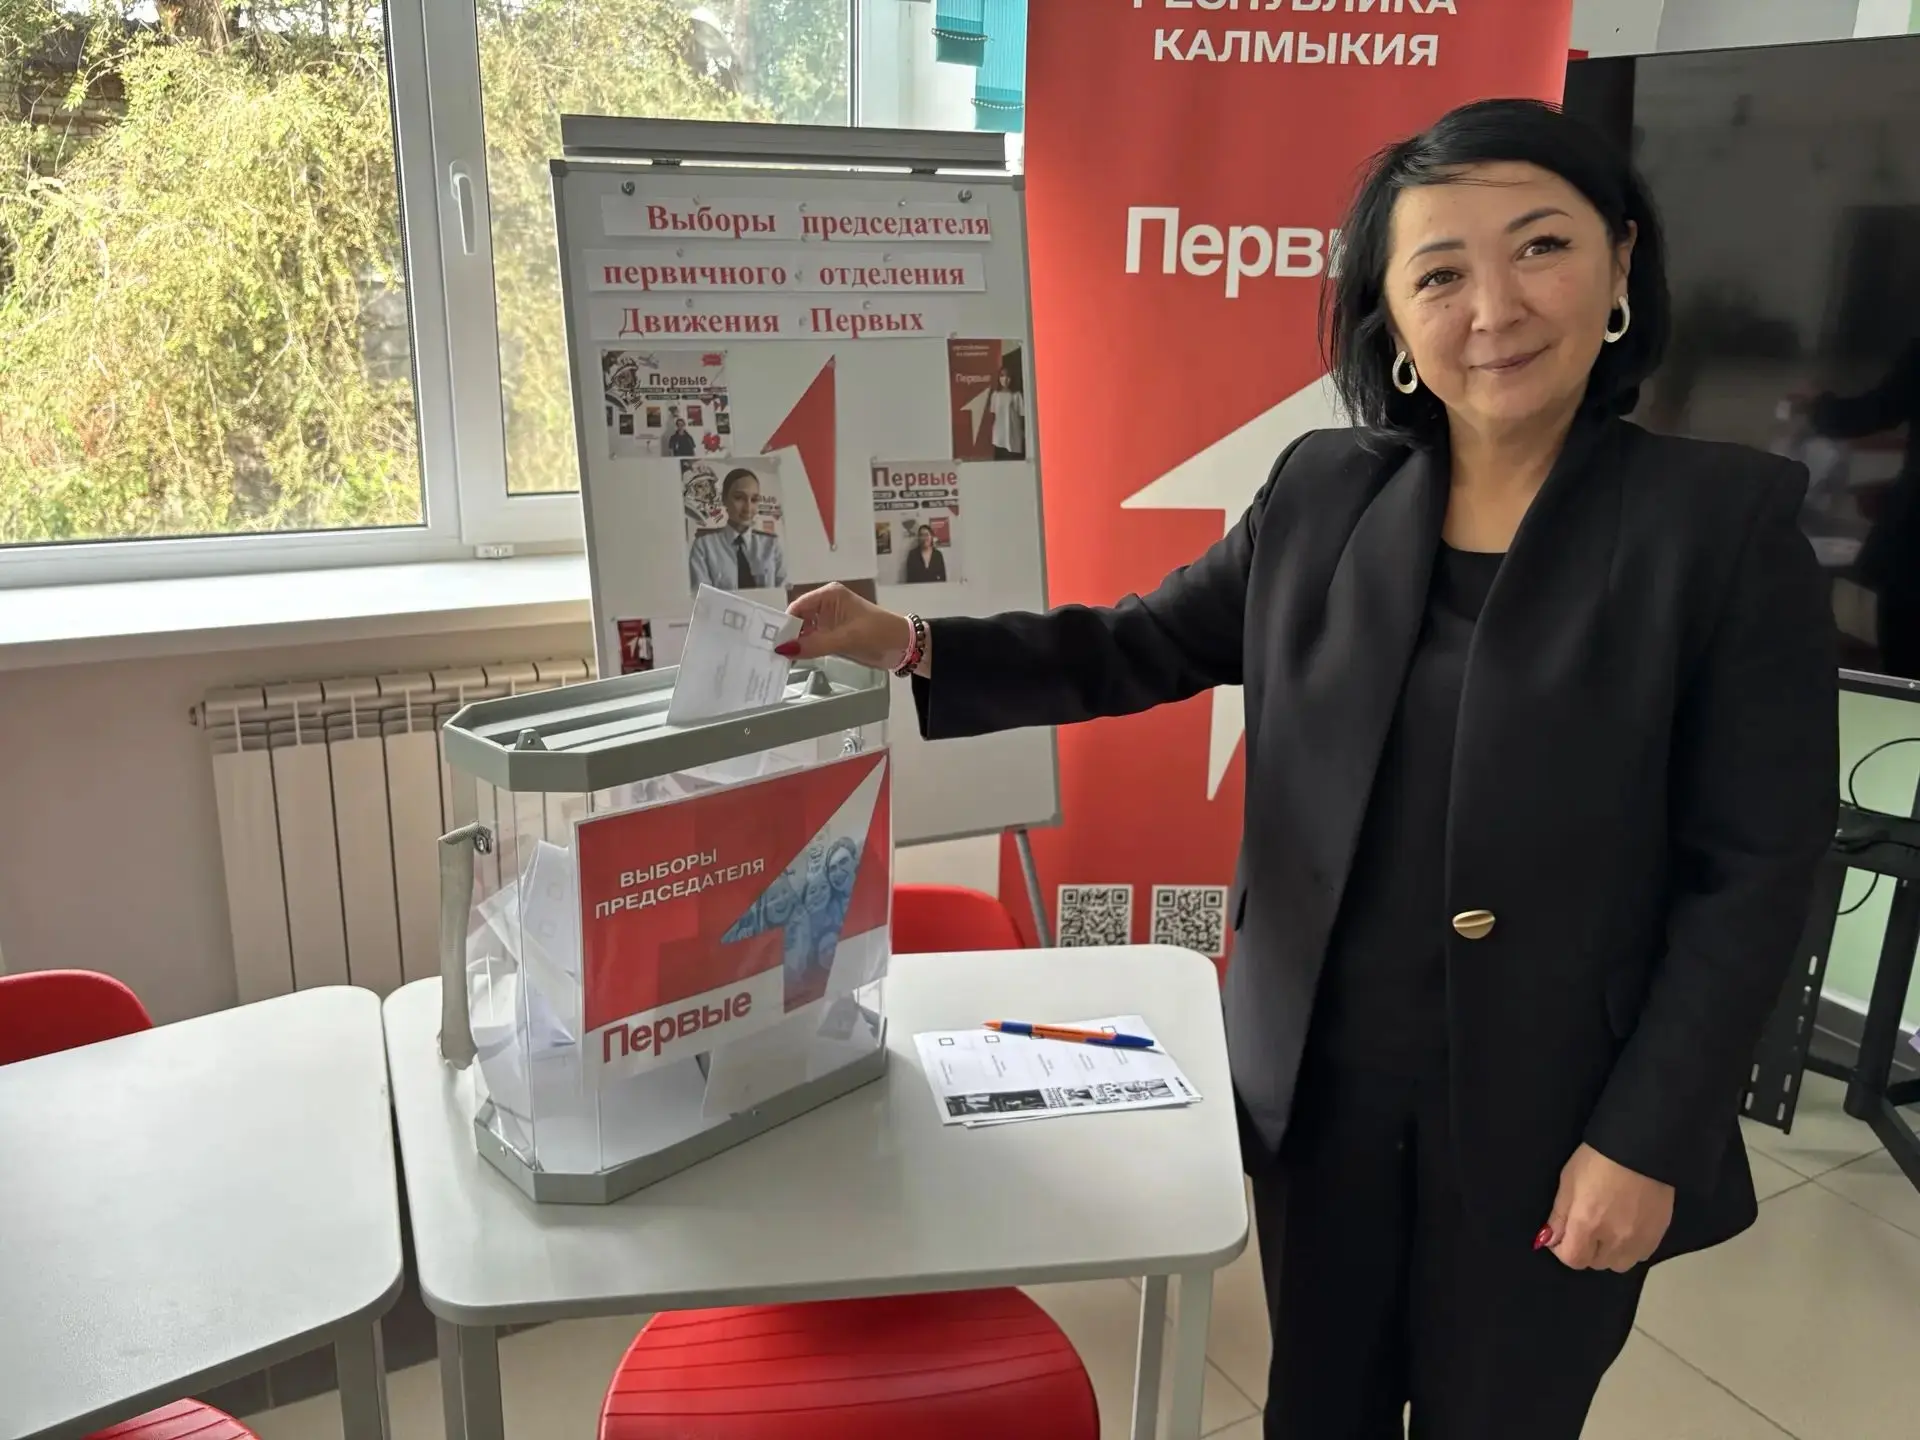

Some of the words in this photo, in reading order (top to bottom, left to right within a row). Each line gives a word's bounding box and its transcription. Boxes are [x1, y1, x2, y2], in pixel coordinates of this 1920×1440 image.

[1153, 28, 1439, 67] КАЛМЫКИЯ
[646, 204, 777, 238] Выборы
[803, 213, 991, 241] председателя
[1125, 206, 1346, 299] Перв
[604, 265, 787, 291] первичного
[819, 265, 965, 287] отделения
[618, 308, 780, 338] Движения
[810, 307, 925, 339] Первых
[649, 373, 707, 388] Первые
[871, 467, 958, 491] Первые
[619, 848, 717, 888] ВЫБОРЫ
[595, 858, 765, 919] ПРЕДСЕДАТЕЛЯ
[602, 992, 753, 1063] Первые
